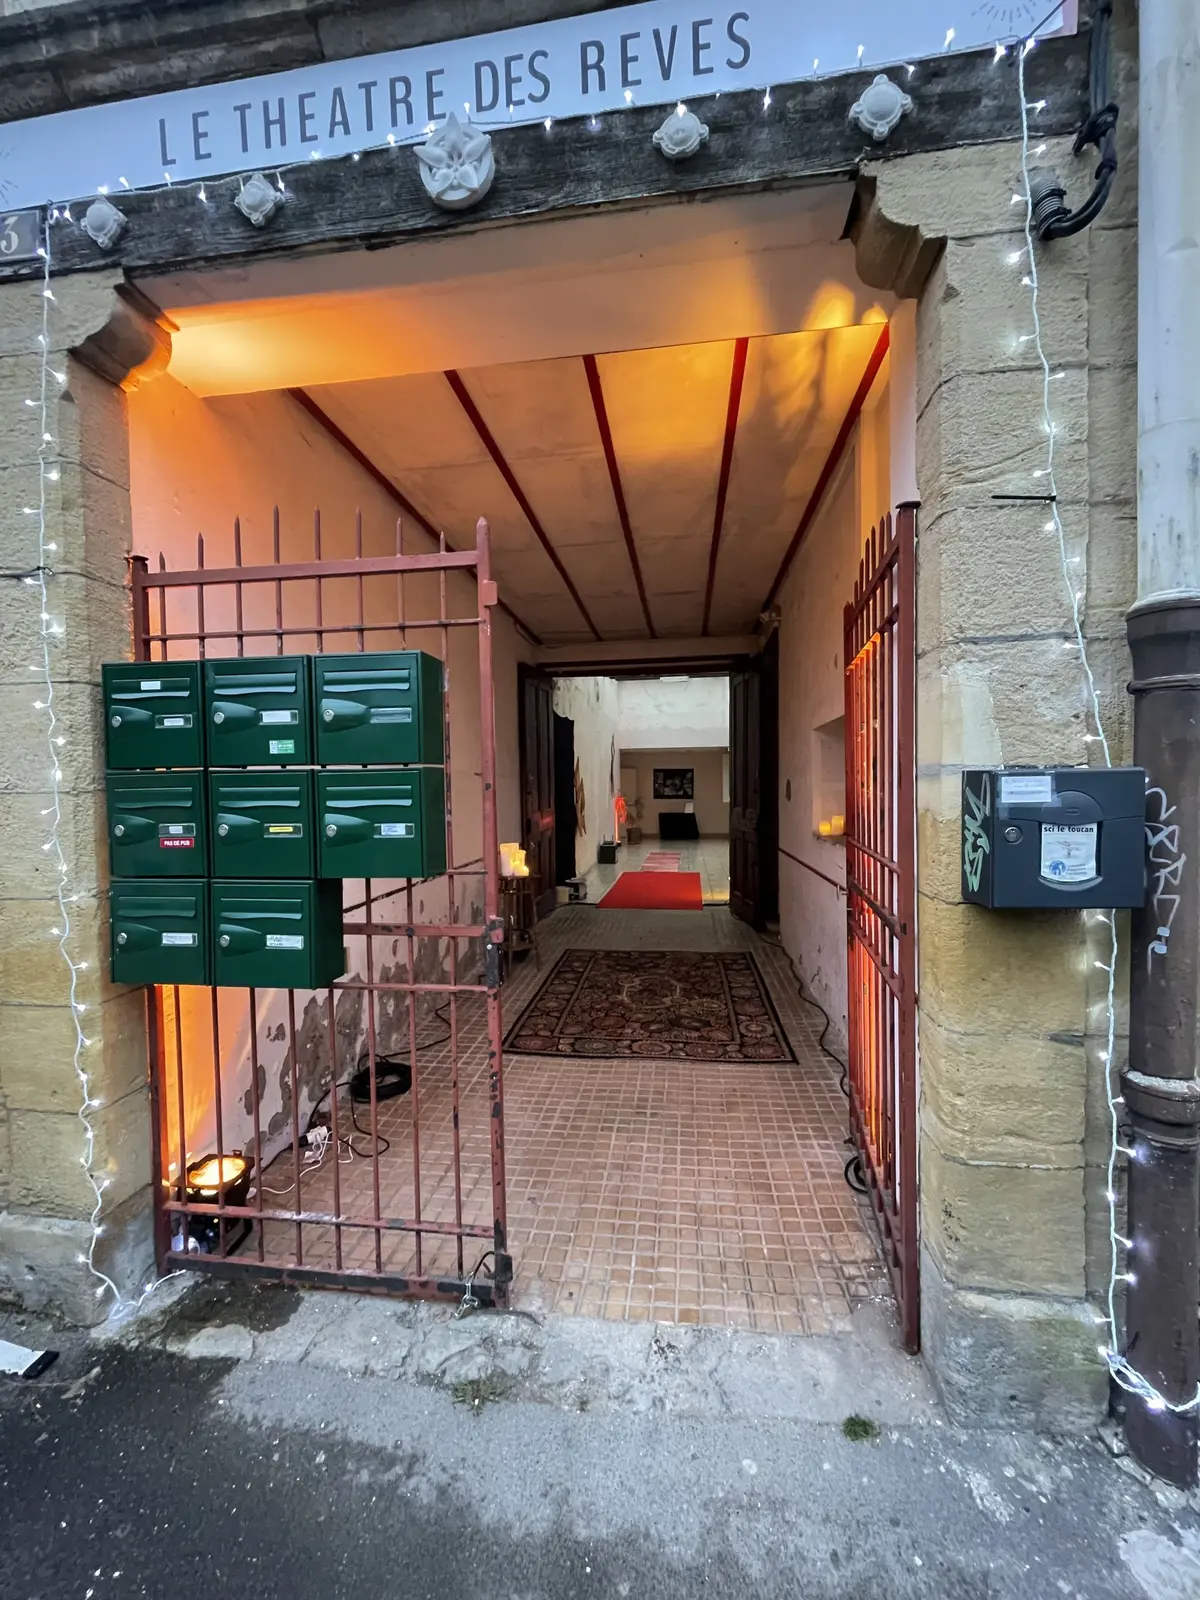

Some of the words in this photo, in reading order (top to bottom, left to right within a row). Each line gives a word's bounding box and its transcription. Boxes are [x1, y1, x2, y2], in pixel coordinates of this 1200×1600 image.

[159, 111, 211, 166] LE
[234, 69, 447, 152] THEATRE
[475, 50, 550, 112] DES
[581, 13, 750, 94] REVES
[1043, 825, 1055, 833] sci
[1057, 825, 1065, 833] le
[1068, 825, 1094, 833] toucan
